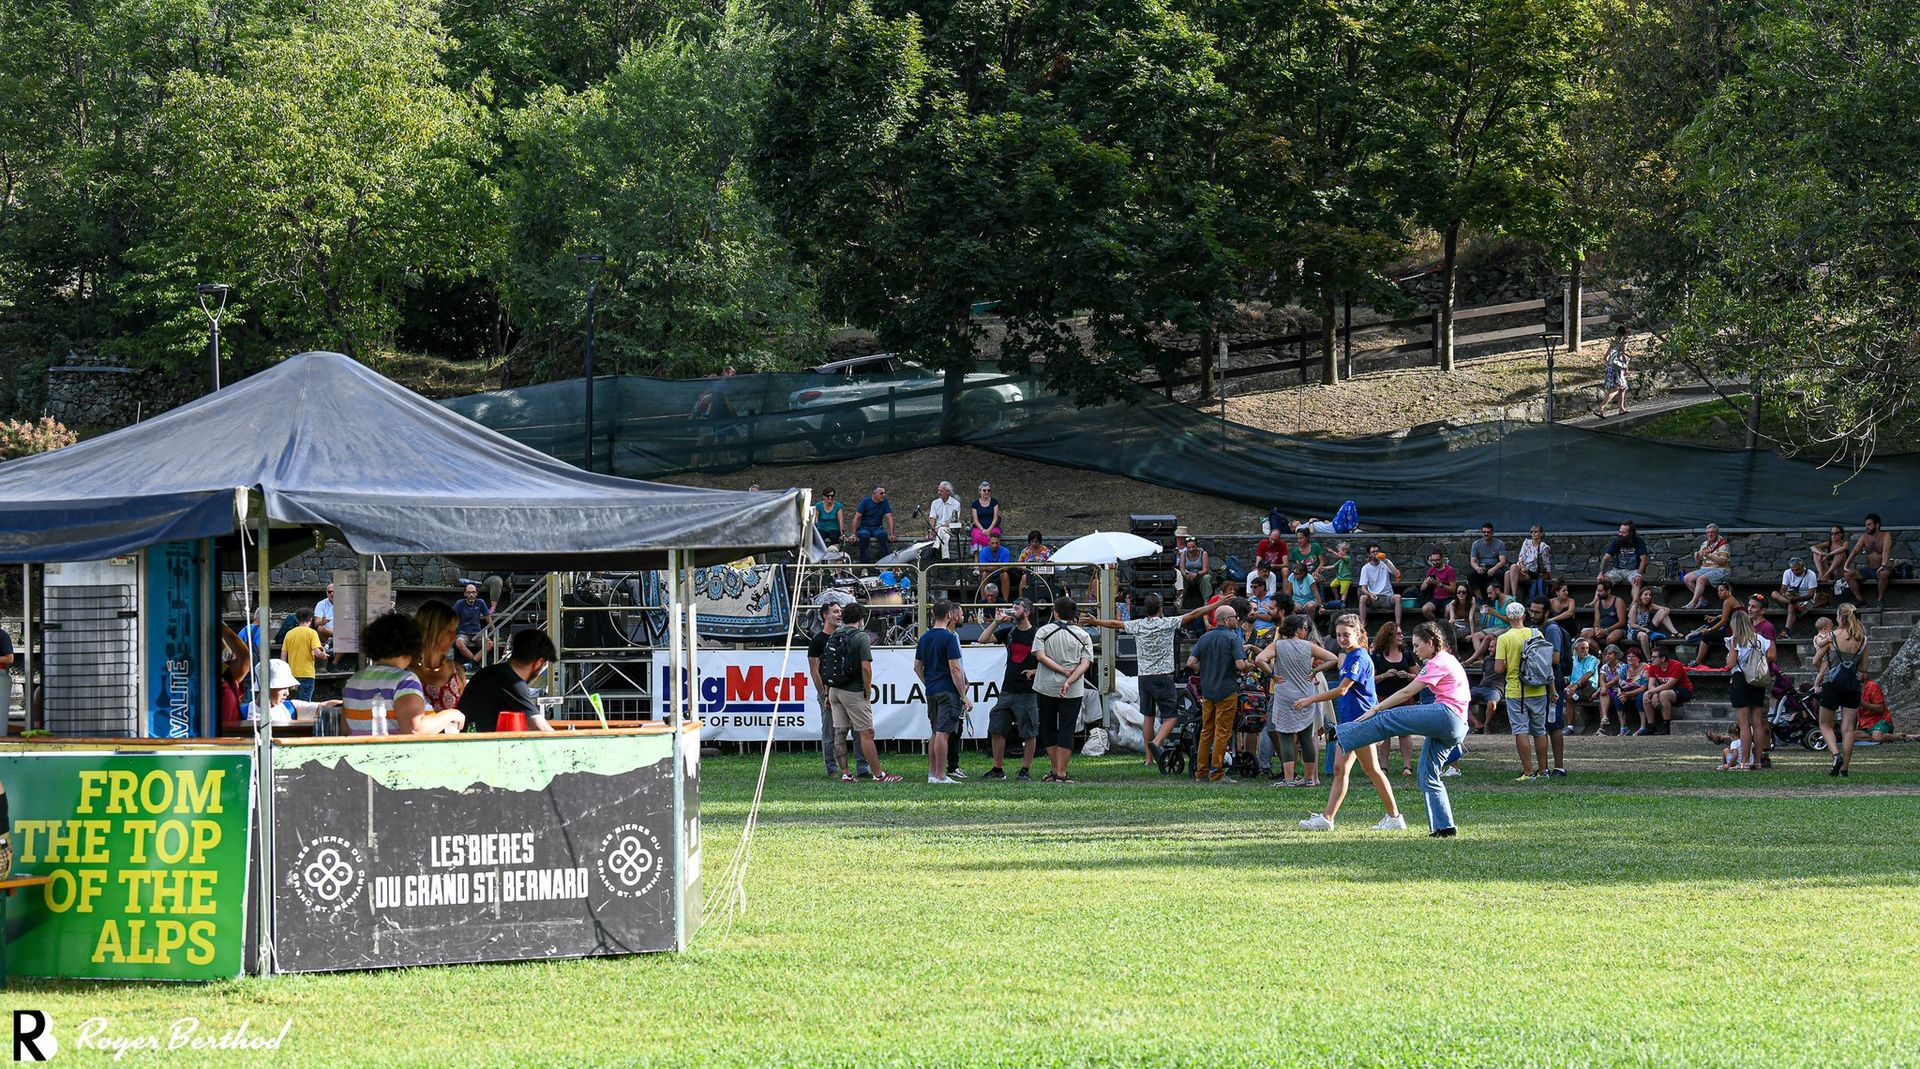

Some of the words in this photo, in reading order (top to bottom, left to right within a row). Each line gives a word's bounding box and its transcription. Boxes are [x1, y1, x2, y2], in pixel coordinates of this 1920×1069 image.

[710, 715, 730, 727] OF
[76, 769, 226, 815] FROM
[14, 819, 111, 864] THE
[123, 819, 222, 865] TOP
[430, 835, 465, 868] LES
[468, 832, 535, 866] BIERES
[44, 869, 108, 914] OF
[118, 869, 218, 915] THE
[375, 875, 400, 909] DU
[405, 873, 470, 907] GRAND
[502, 867, 589, 903] BERNARD
[91, 919, 217, 966] ALPS
